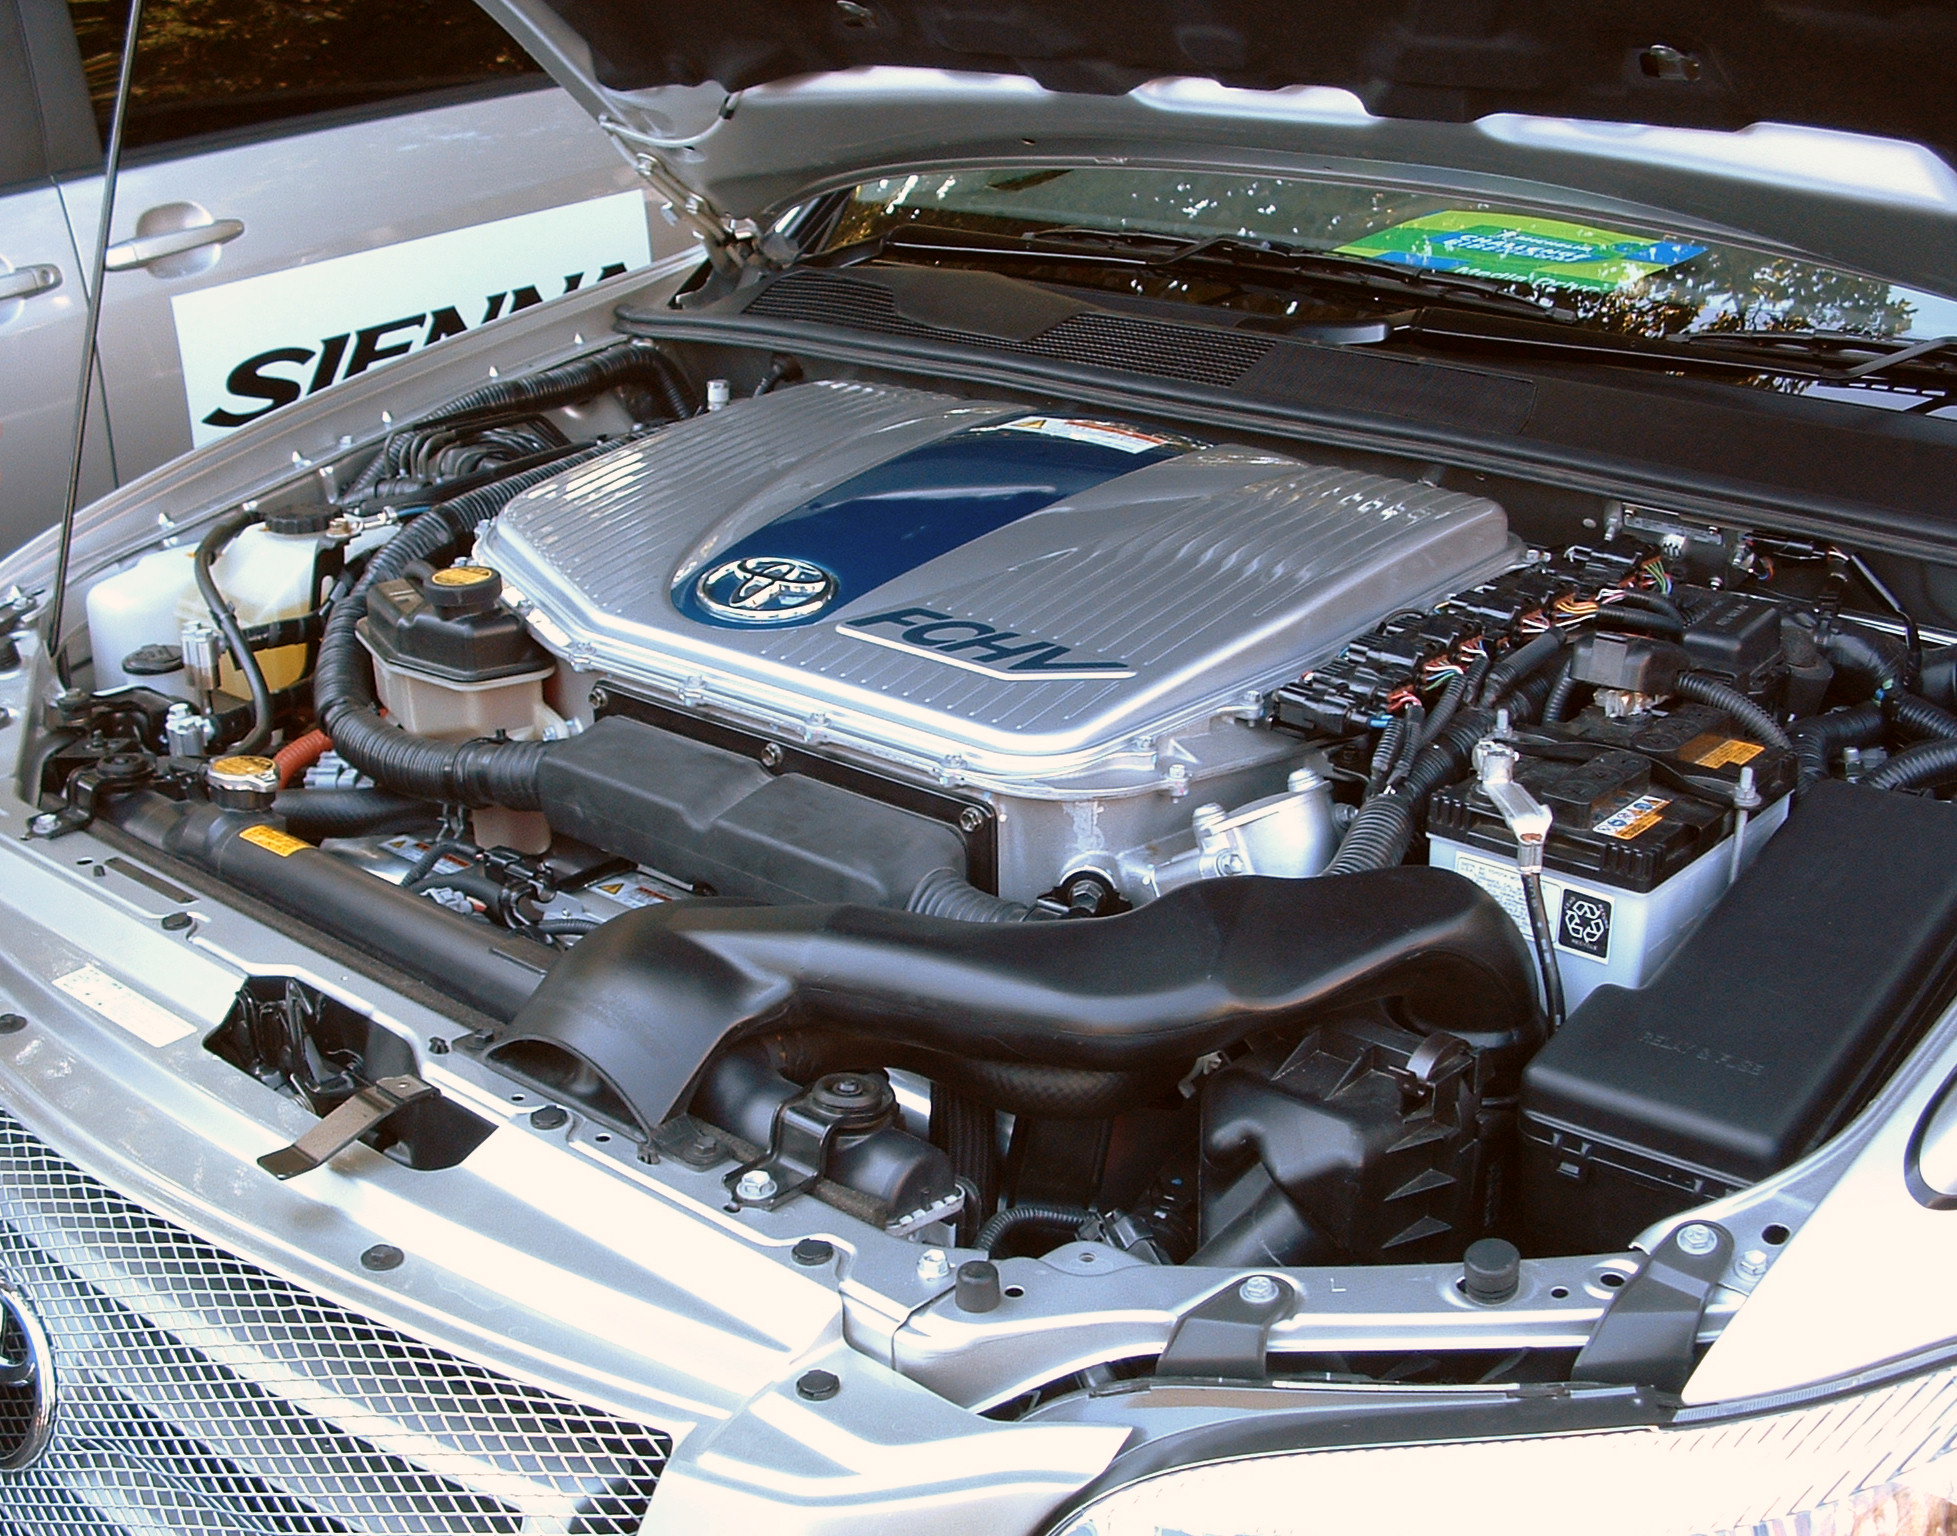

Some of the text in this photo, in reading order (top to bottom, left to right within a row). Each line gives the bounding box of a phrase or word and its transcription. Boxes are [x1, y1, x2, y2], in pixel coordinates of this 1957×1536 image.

[1453, 266, 1529, 283] Media
[202, 262, 628, 428] SIE
[845, 607, 1130, 672] FCHV
